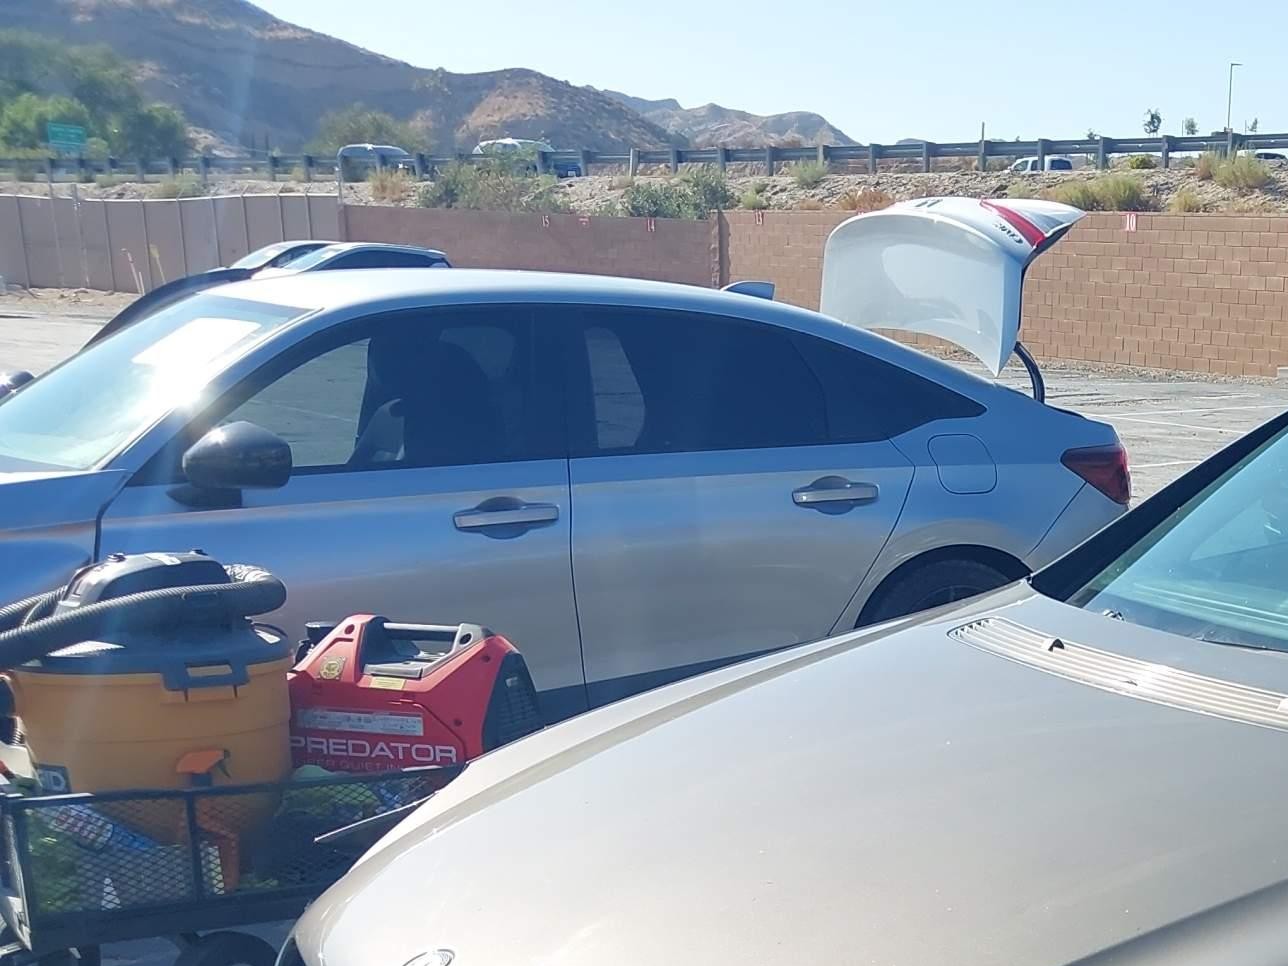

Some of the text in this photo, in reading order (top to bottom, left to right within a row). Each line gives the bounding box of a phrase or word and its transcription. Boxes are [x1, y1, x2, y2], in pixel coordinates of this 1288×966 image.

[541, 215, 550, 228] 15
[1125, 213, 1136, 232] 10
[289, 735, 457, 763] PREDATOR
